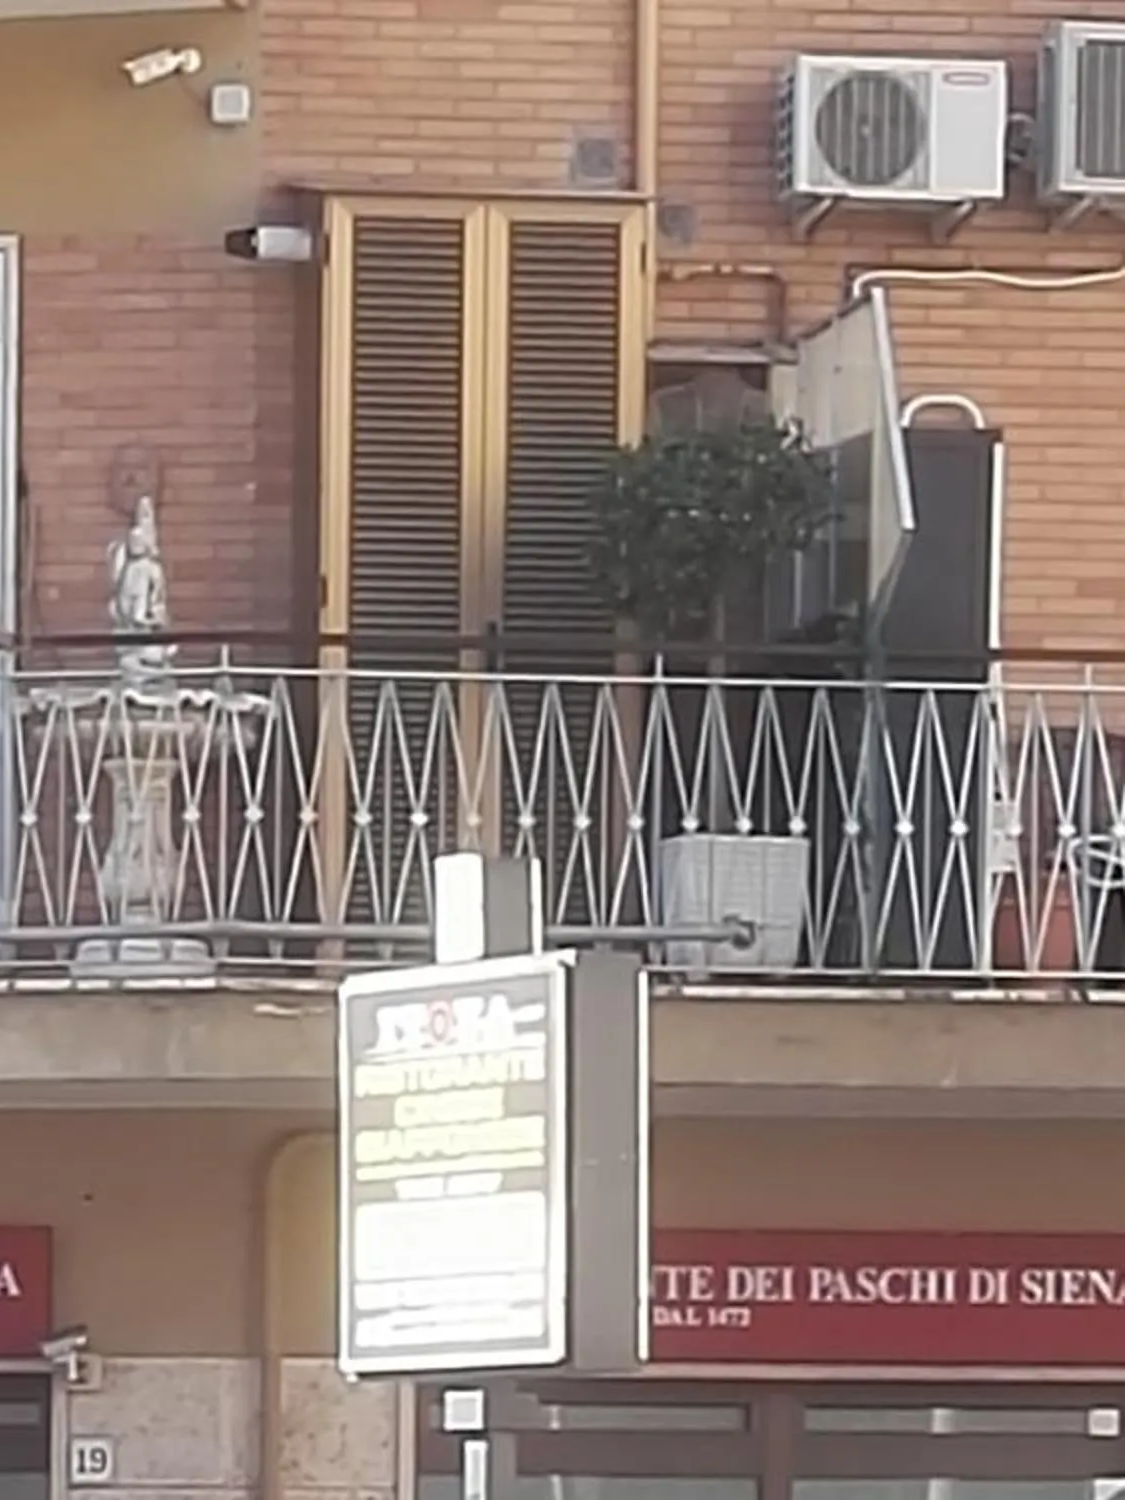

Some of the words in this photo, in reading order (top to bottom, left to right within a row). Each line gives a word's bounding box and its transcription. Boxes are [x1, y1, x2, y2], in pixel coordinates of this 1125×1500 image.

[727, 1265, 794, 1302] DEI
[810, 1267, 958, 1304] PASCHI
[969, 1268, 1009, 1304] DI
[653, 1306, 702, 1326] DAL
[77, 1447, 107, 1473] 19
